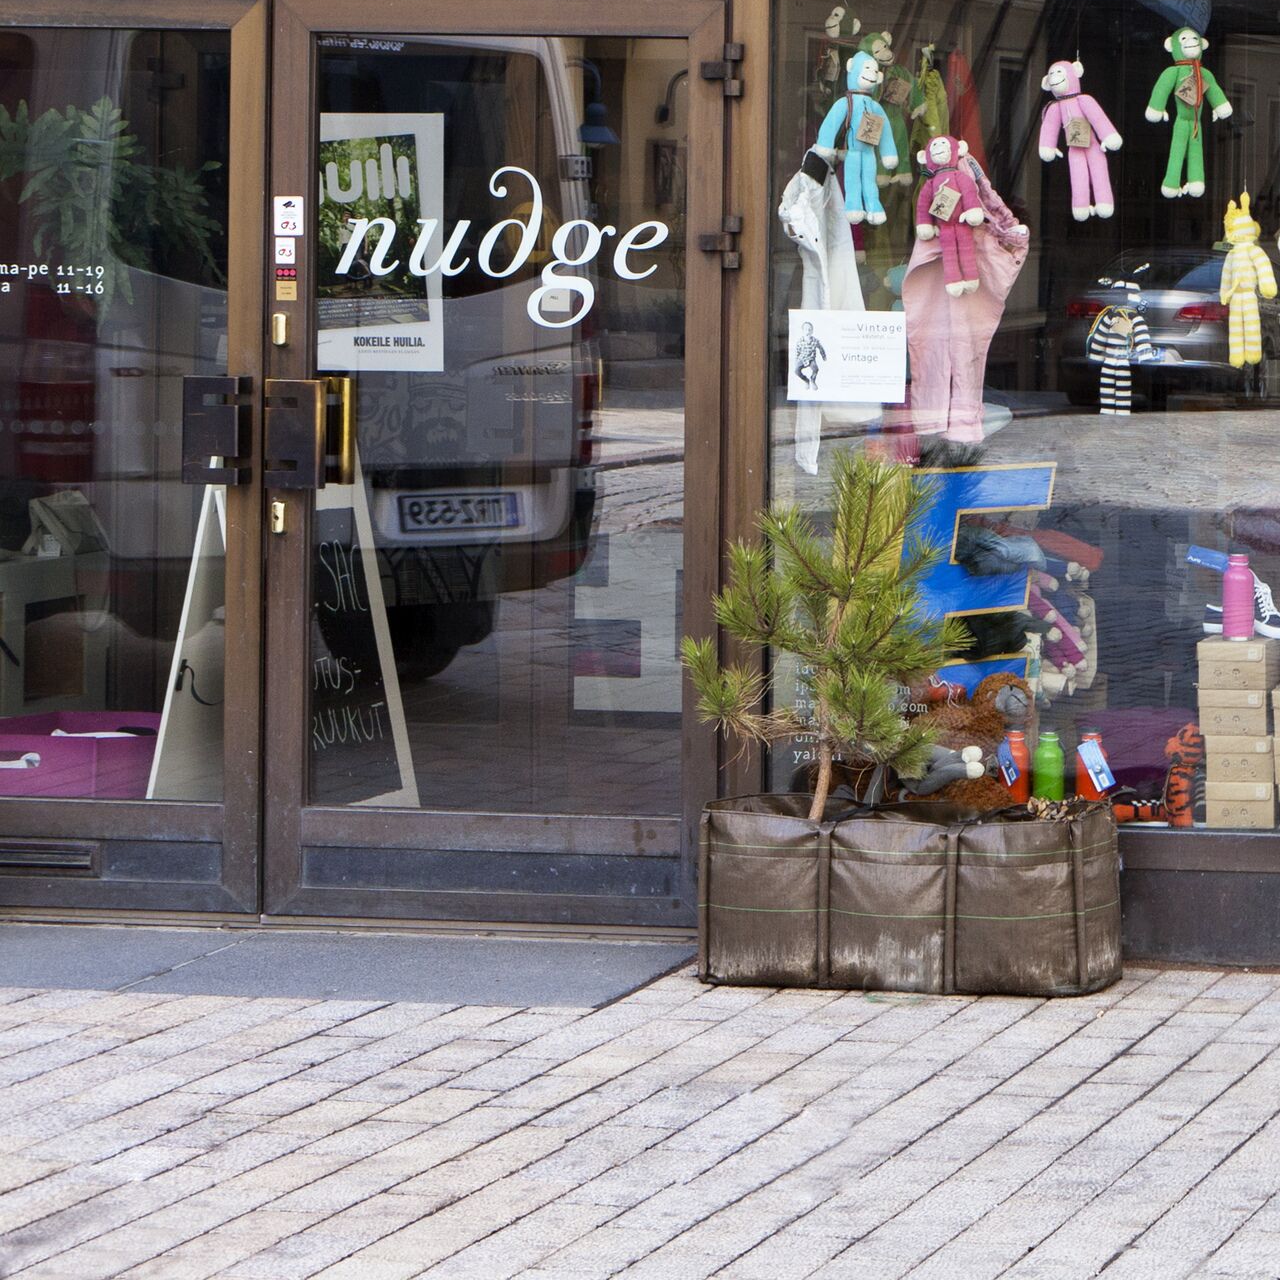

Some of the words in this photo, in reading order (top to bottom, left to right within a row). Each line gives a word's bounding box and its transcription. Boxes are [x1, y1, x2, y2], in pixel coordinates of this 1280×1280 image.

[319, 142, 412, 205] uili
[334, 166, 670, 329] nudge
[56, 265, 105, 280] 11-19
[856, 323, 903, 334] Vintage
[353, 336, 391, 348] KOKEILE
[392, 336, 426, 348] HUILIA.
[841, 352, 879, 364] Vintage
